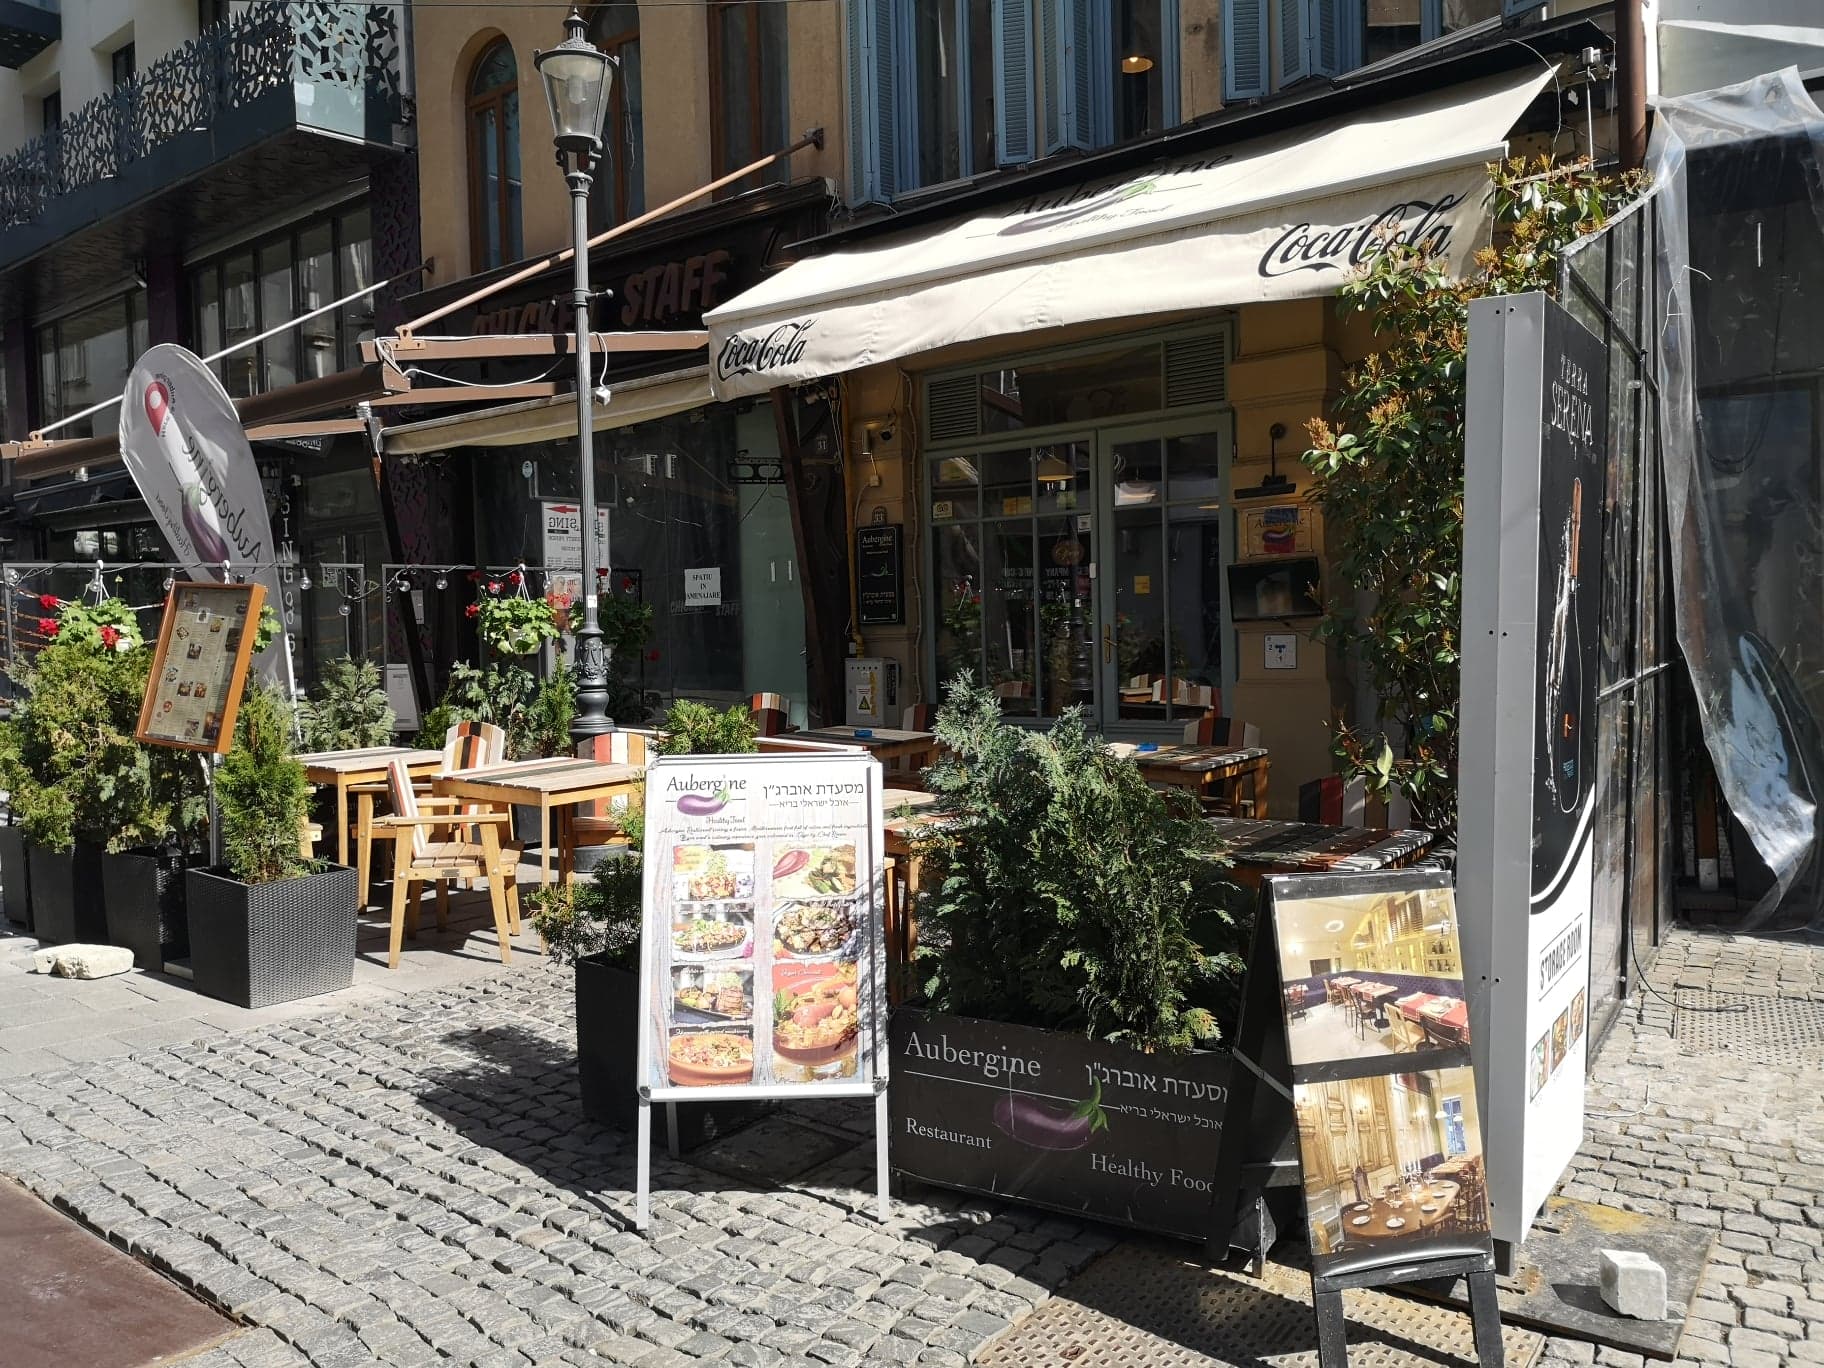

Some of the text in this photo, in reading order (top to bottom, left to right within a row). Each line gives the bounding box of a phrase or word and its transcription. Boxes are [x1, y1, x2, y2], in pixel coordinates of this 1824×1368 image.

[621, 250, 731, 327] STAFF
[717, 319, 818, 382] Coca-Cola
[1560, 354, 1588, 395] TERRA
[1551, 380, 1593, 447] SERENA
[666, 773, 747, 796] Aubergine
[816, 783, 864, 795] מסעדת
[829, 798, 849, 807] אוכל
[1541, 923, 1582, 990] STORAGE ROOM
[903, 1031, 1042, 1078] Aubergine
[1119, 1104, 1148, 1118] בריא
[1150, 1107, 1191, 1124] ישראלי
[905, 1116, 993, 1149] Restaurant
[1091, 1152, 1164, 1188] Healthy
